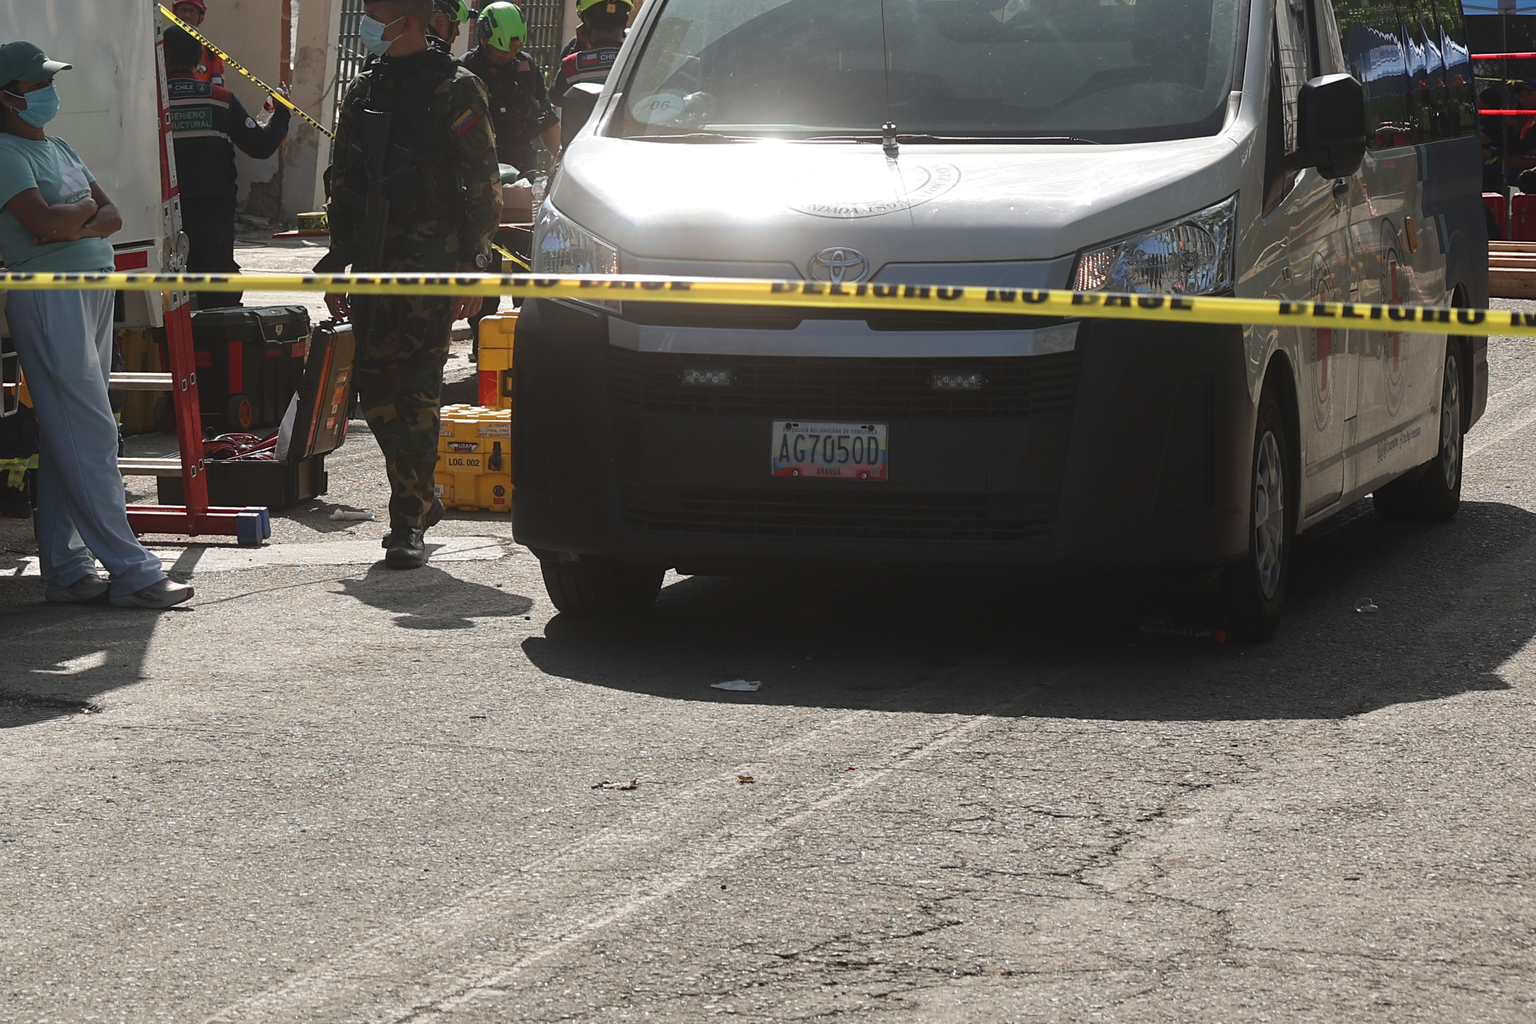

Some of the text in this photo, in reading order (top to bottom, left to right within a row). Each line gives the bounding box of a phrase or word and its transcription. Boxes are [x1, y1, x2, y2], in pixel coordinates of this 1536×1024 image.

[650, 100, 671, 111] 06
[170, 110, 206, 119] GENIERO
[171, 120, 211, 129] RUCTURAL
[448, 458, 480, 467] LOG. 002
[816, 467, 841, 476] ARAGUA
